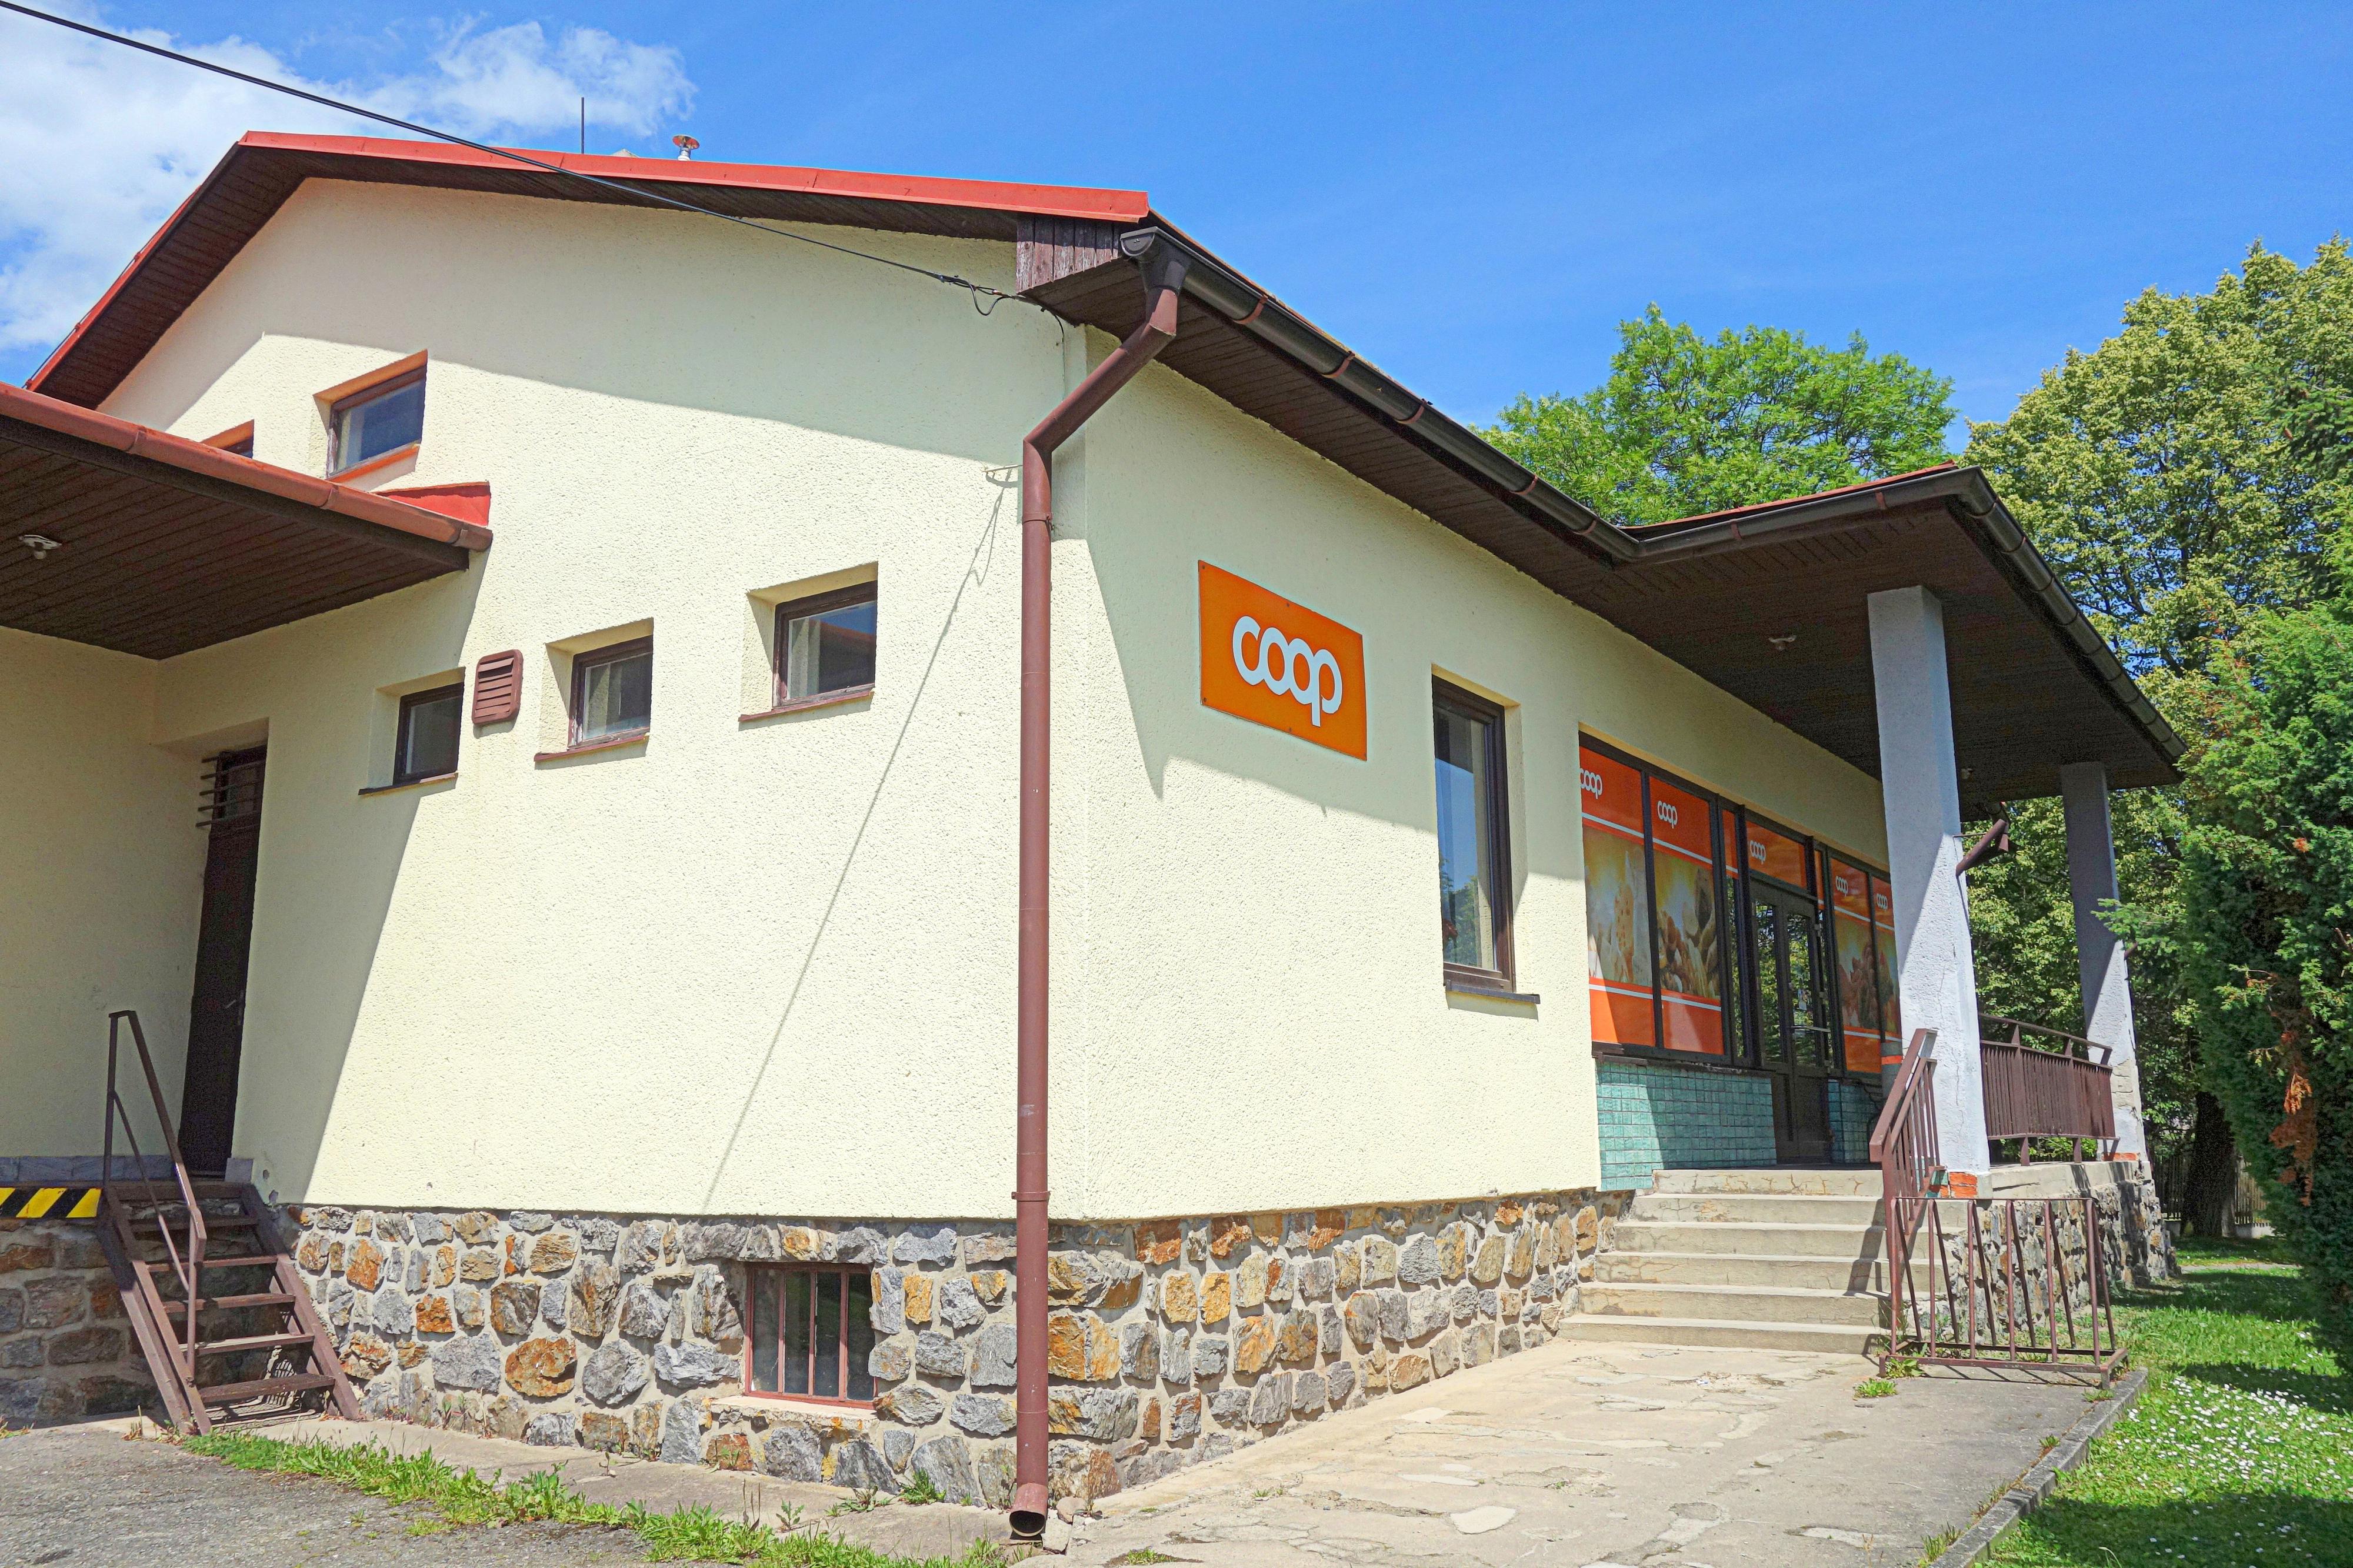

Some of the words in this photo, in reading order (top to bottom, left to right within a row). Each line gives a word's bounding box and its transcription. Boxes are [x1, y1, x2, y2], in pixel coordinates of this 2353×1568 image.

[1232, 616, 1343, 728] coop
[1580, 768, 1603, 799] coop
[1657, 800, 1678, 829] coop
[1749, 840, 1766, 865] coop
[1835, 875, 1848, 896] coop
[1877, 893, 1888, 910] coop
